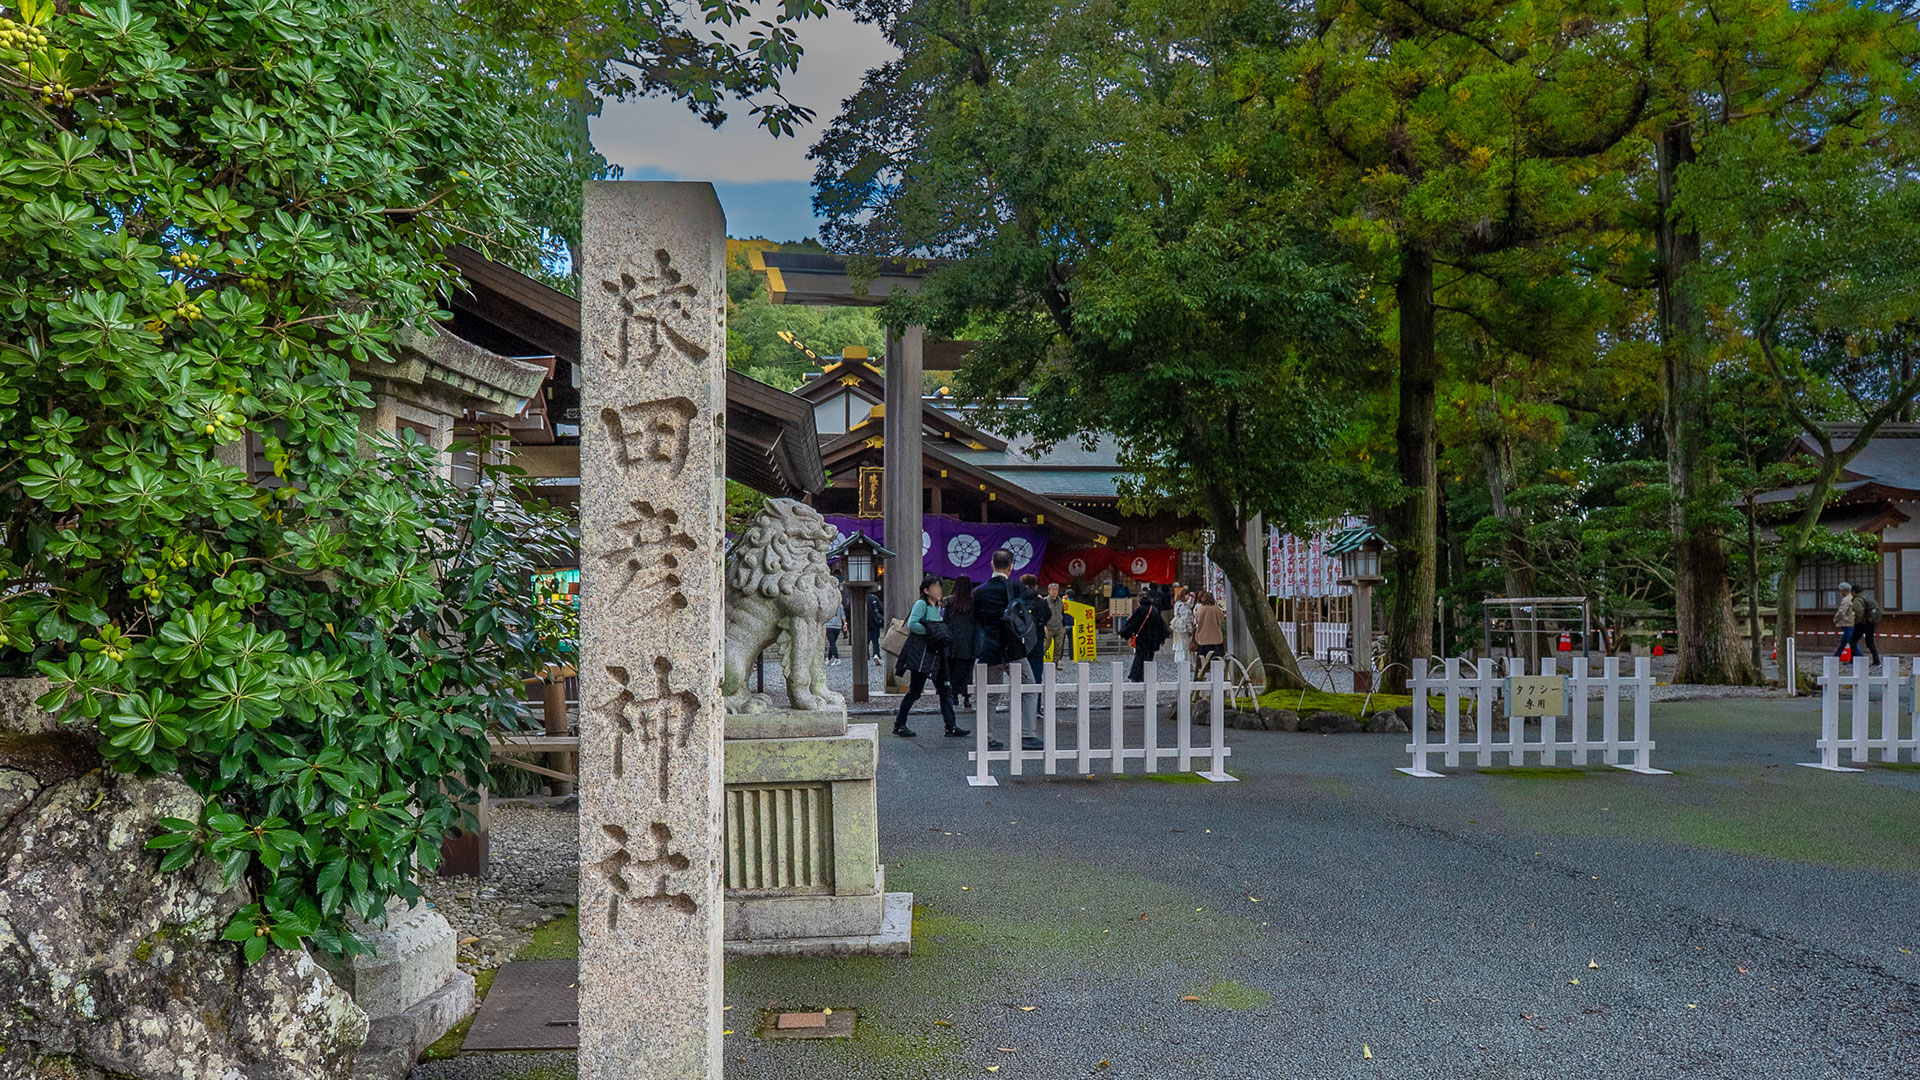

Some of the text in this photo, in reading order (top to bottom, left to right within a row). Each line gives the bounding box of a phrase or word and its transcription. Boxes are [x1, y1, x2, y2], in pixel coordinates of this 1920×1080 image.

[1078, 623, 1086, 658] まつり
[1085, 609, 1094, 657] 祝七五三
[1516, 685, 1560, 695] タクシー
[1525, 698, 1545, 710] 専用
